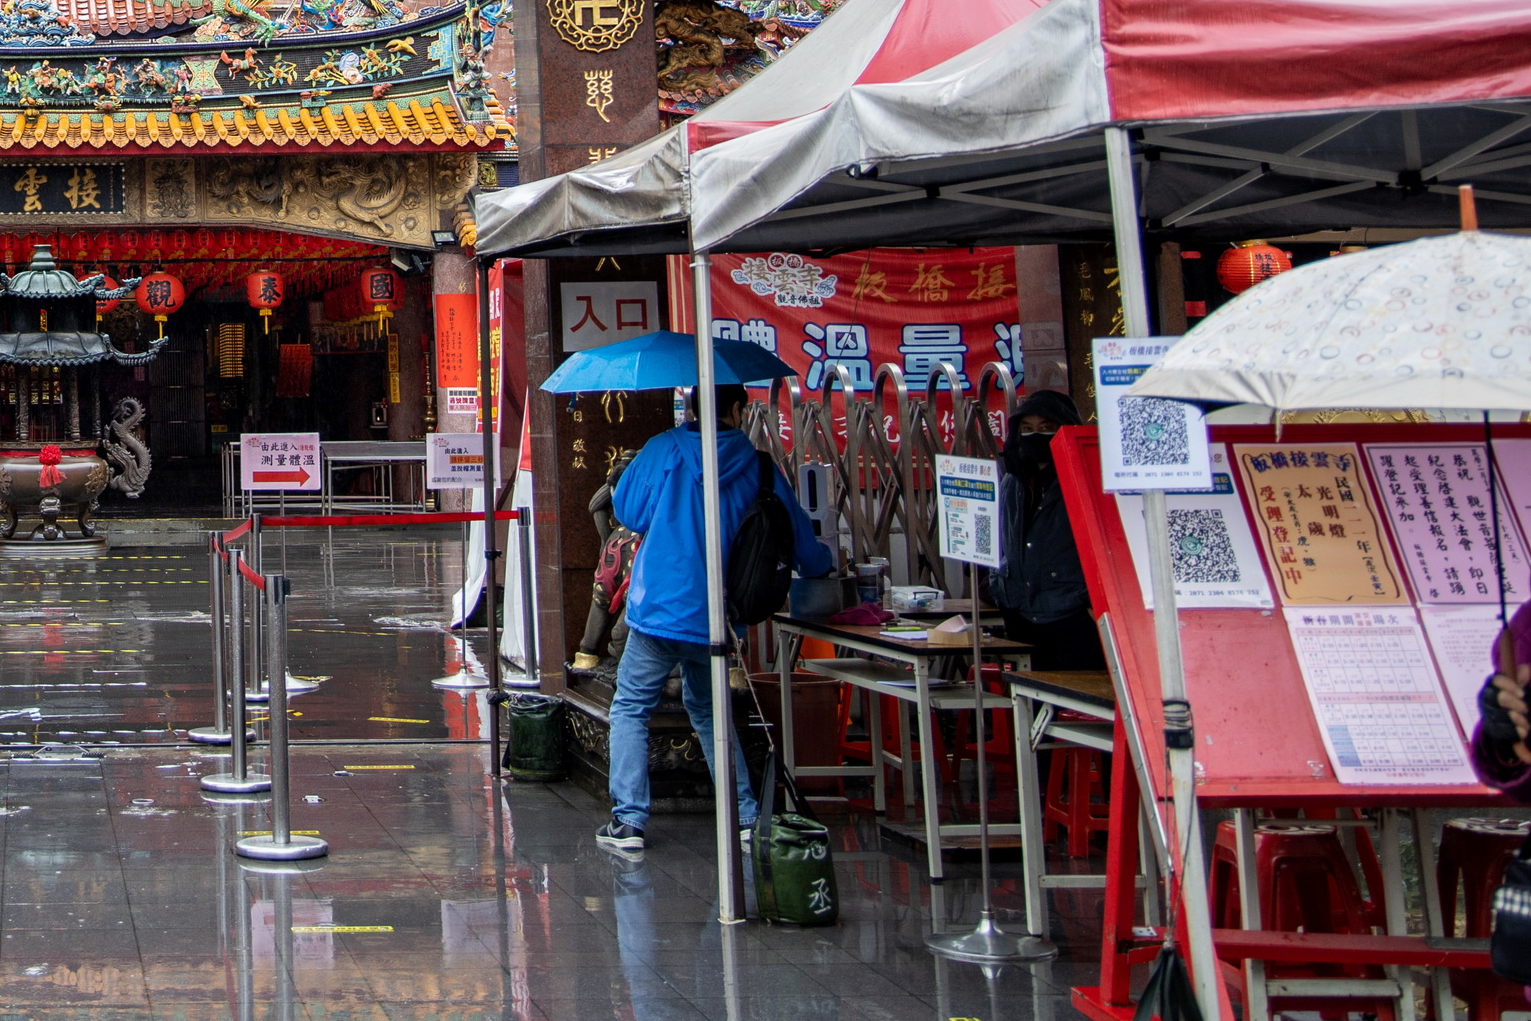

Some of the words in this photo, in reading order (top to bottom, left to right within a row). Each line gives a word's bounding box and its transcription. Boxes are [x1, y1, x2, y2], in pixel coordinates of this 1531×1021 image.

[146, 280, 176, 308] 觀
[258, 277, 281, 304] 泰
[371, 273, 394, 300] 國
[570, 295, 649, 333] 入口
[261, 442, 298, 452] 由此進入
[261, 453, 316, 466] 測量體溫
[1250, 450, 1352, 474] 板橋接雲寺
[1259, 484, 1303, 586] 受理登記中
